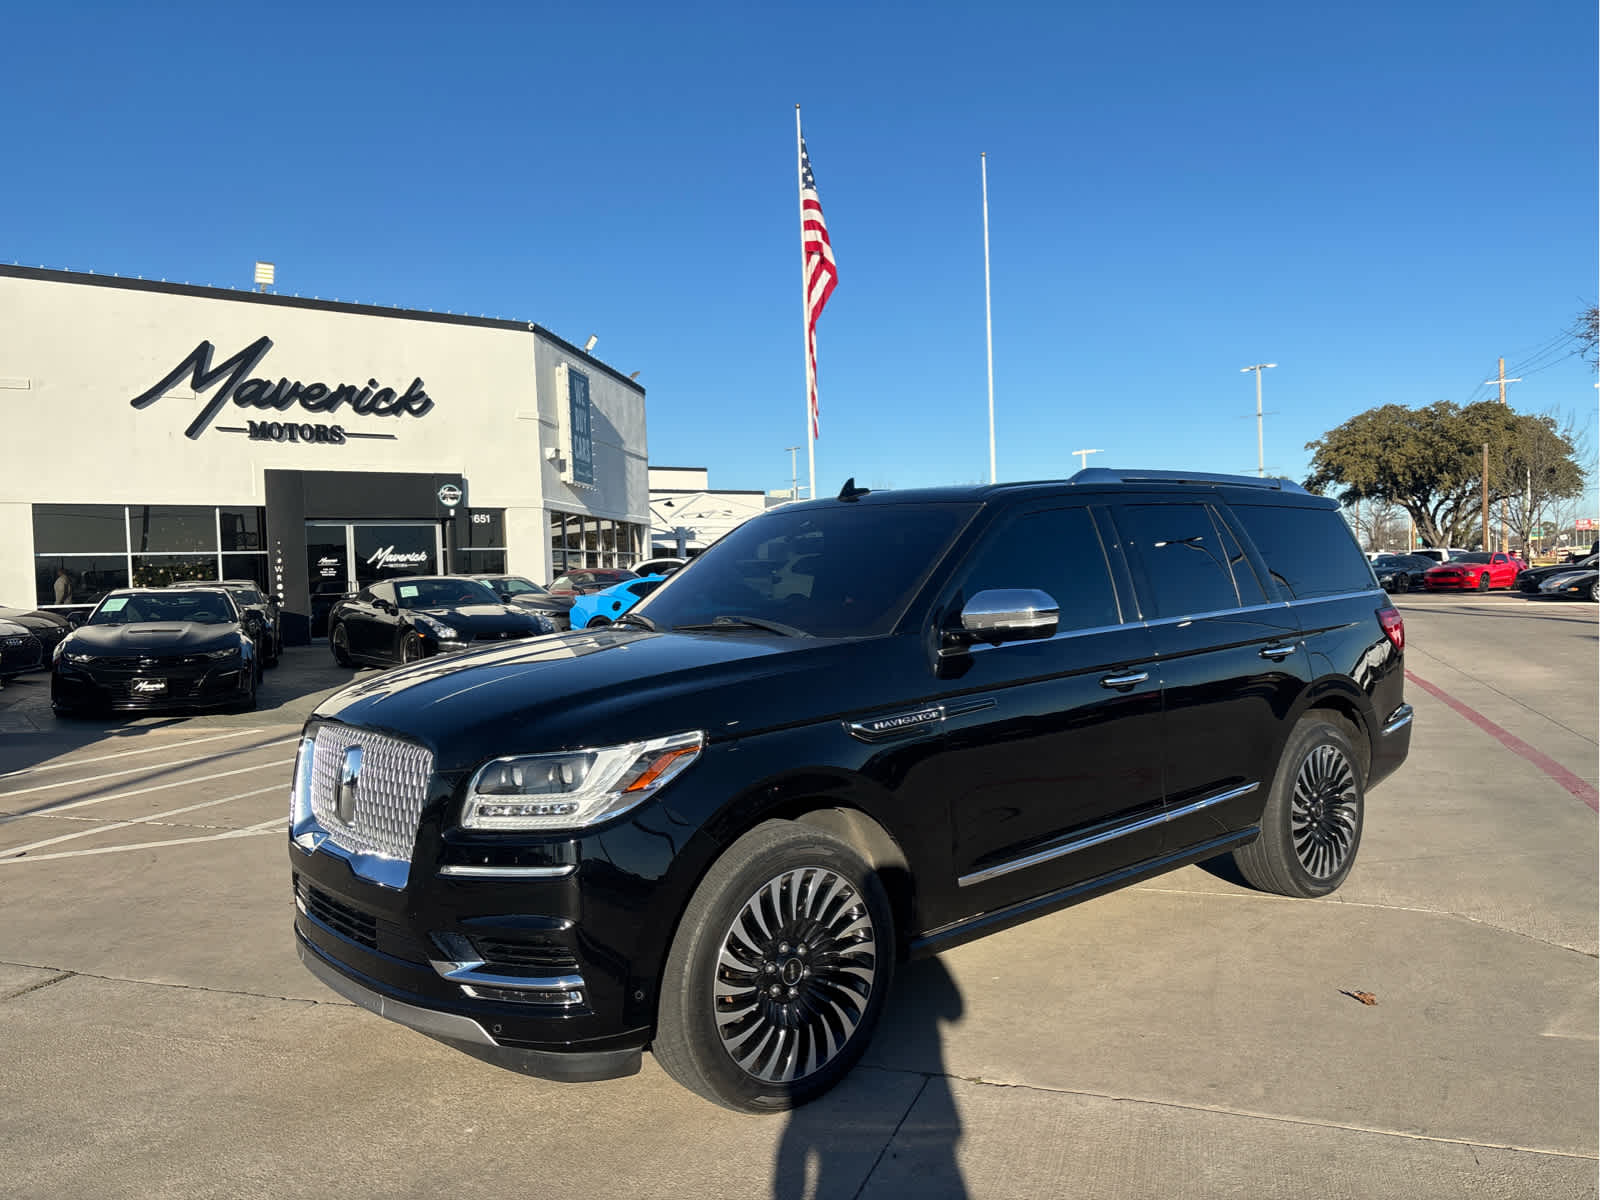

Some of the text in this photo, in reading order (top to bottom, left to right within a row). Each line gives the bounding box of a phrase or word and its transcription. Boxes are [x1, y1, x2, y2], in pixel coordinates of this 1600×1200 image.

[130, 335, 435, 440] Maverick
[247, 420, 346, 445] MOTORS
[366, 544, 428, 570] Maverick
[873, 711, 940, 731] NAVIGATOR
